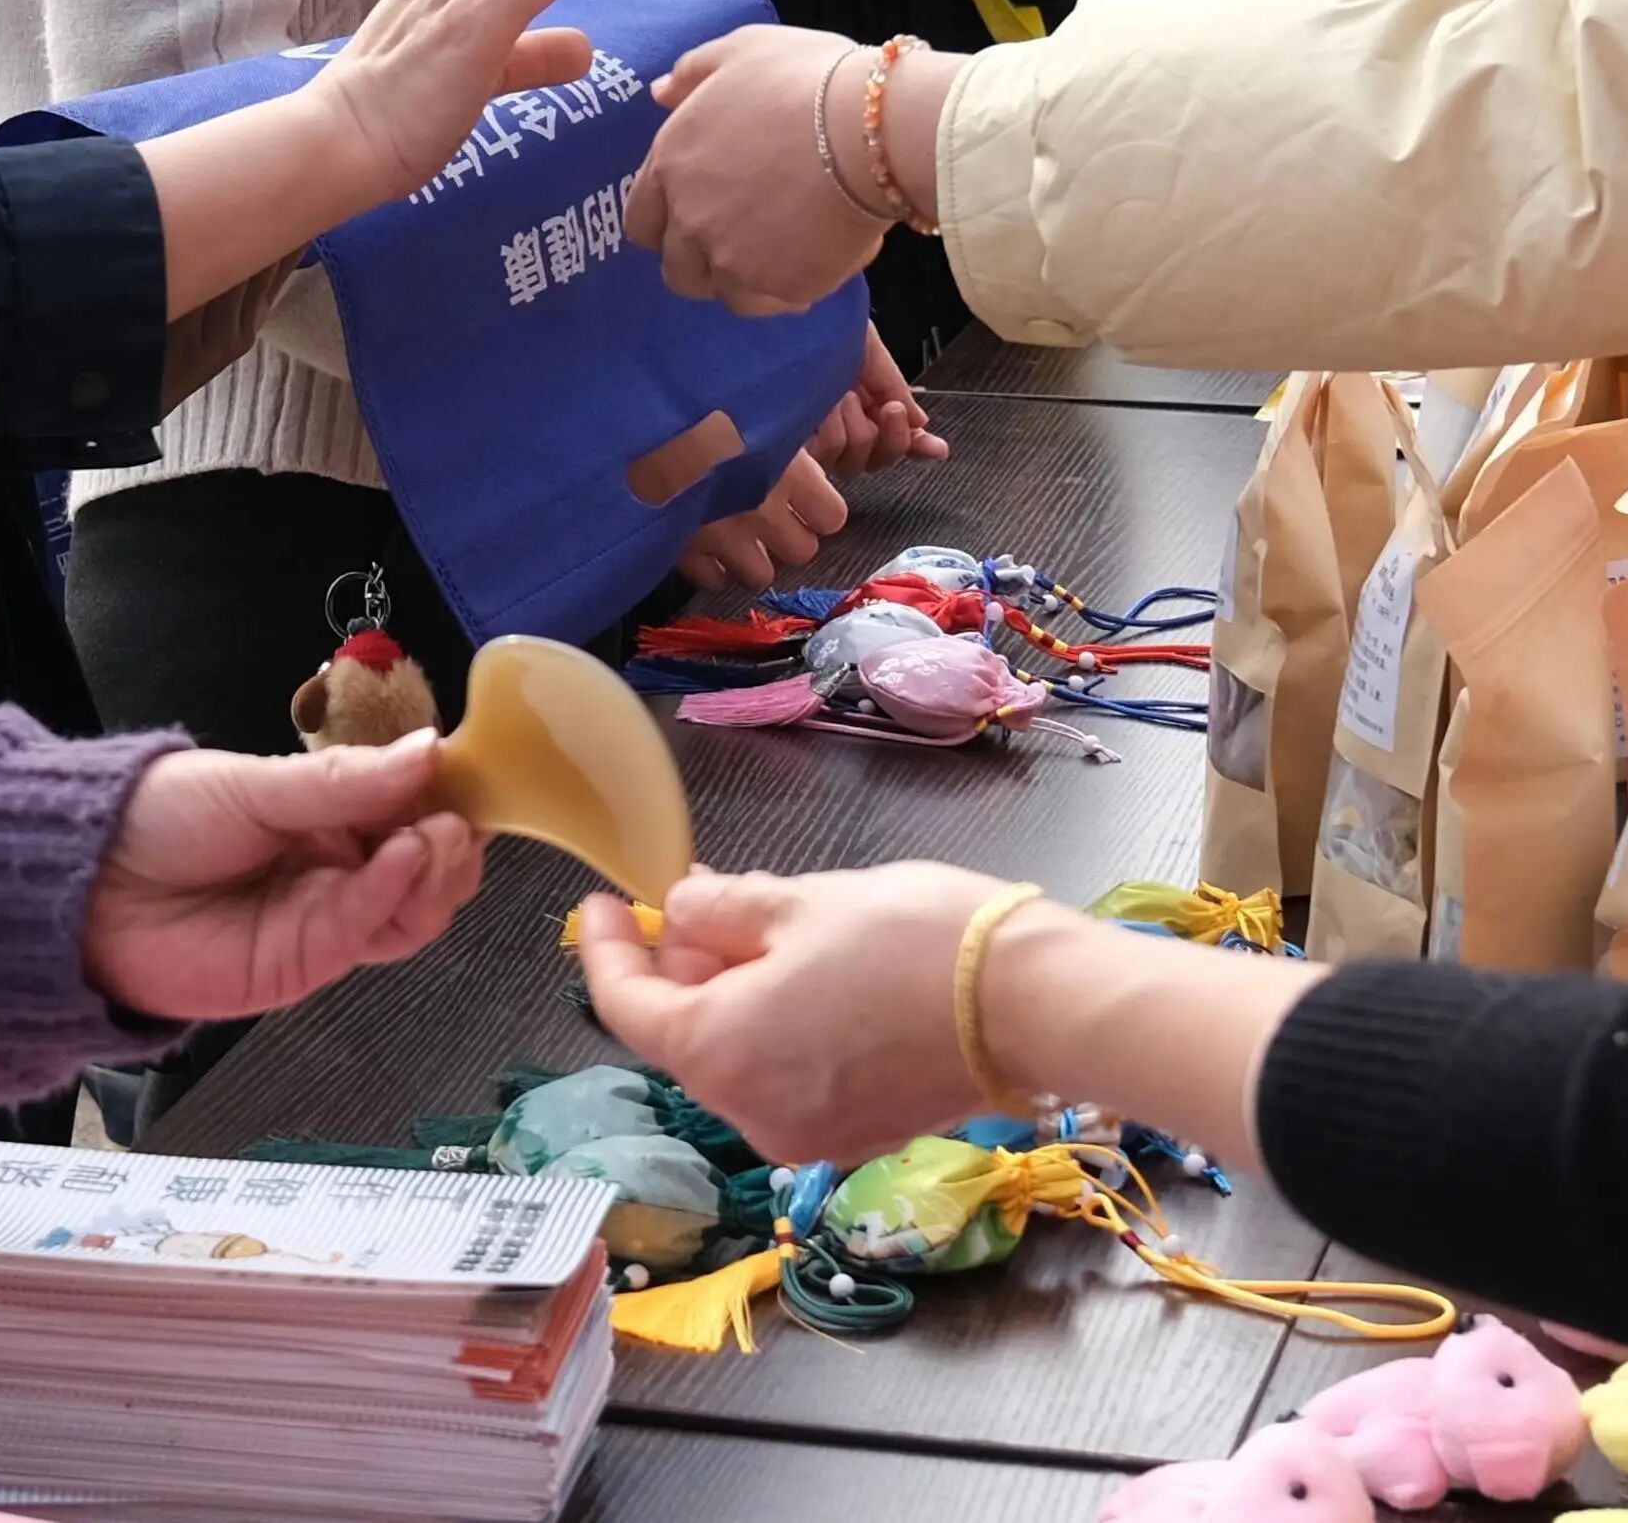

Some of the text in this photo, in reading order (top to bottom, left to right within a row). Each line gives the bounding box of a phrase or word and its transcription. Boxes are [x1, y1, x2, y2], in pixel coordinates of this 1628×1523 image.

[408, 49, 644, 205] 我们全力付
[499, 168, 641, 306] 的健康
